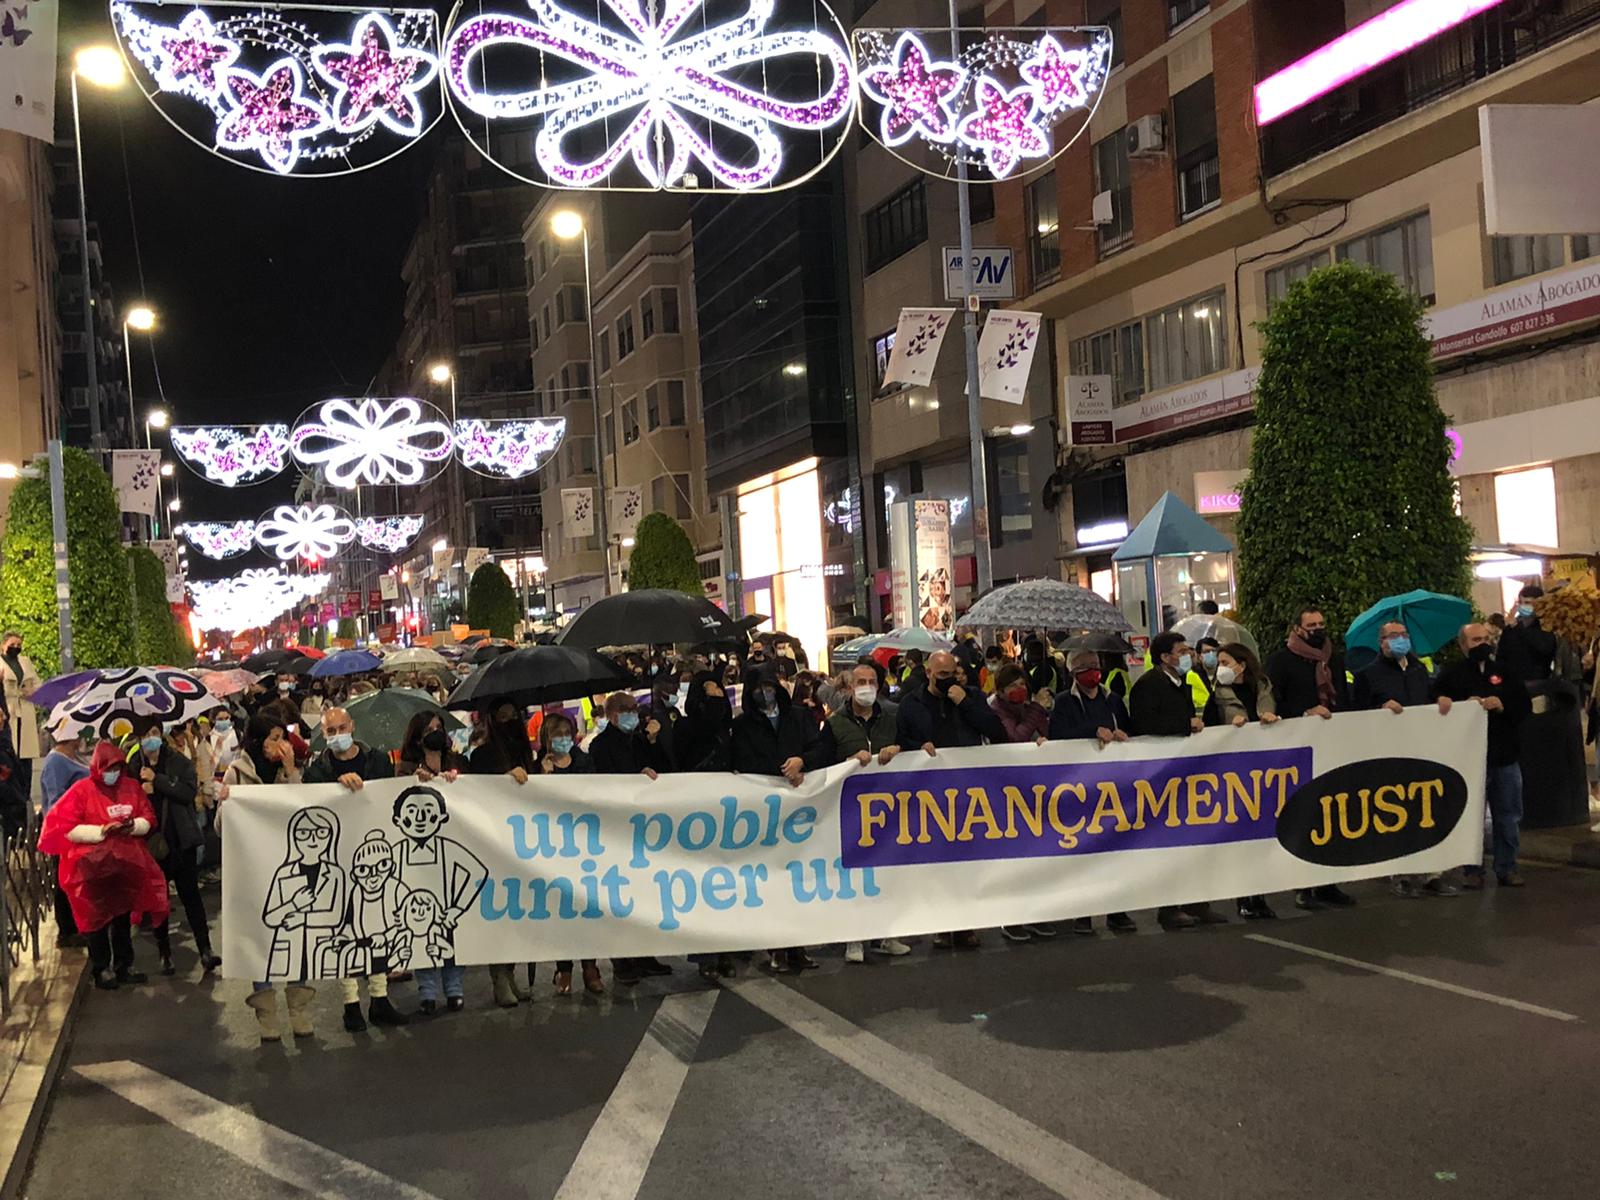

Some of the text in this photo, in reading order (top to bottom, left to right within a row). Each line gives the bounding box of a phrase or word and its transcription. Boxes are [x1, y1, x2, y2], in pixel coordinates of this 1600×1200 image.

[949, 255, 981, 268] ARO
[1510, 321, 1524, 334] 607
[1200, 494, 1240, 507] KIKO
[858, 766, 1444, 849] FINANÇAMENT JUST
[507, 794, 817, 869] un poble
[479, 855, 881, 931] unit per un
